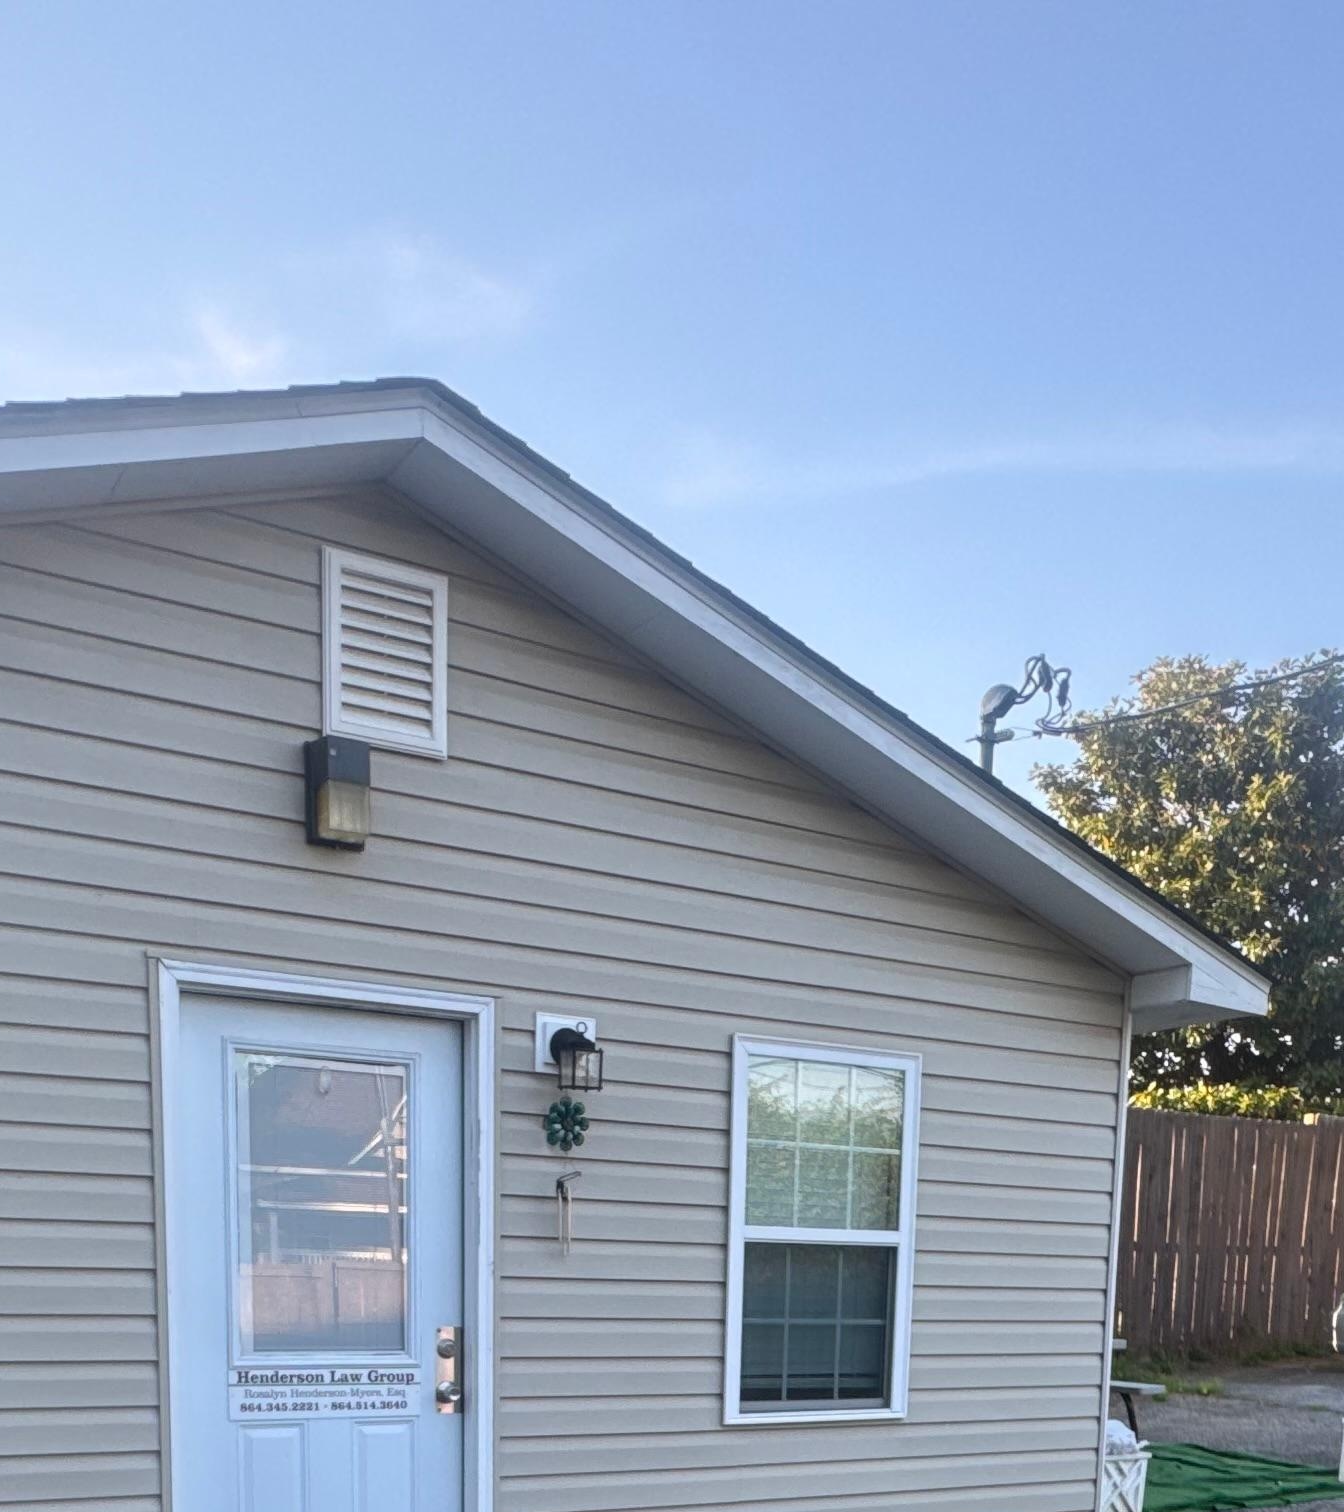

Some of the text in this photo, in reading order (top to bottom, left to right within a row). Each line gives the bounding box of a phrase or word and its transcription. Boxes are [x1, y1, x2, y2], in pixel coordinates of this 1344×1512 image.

[236, 1370, 415, 1385] Henderson Law Group
